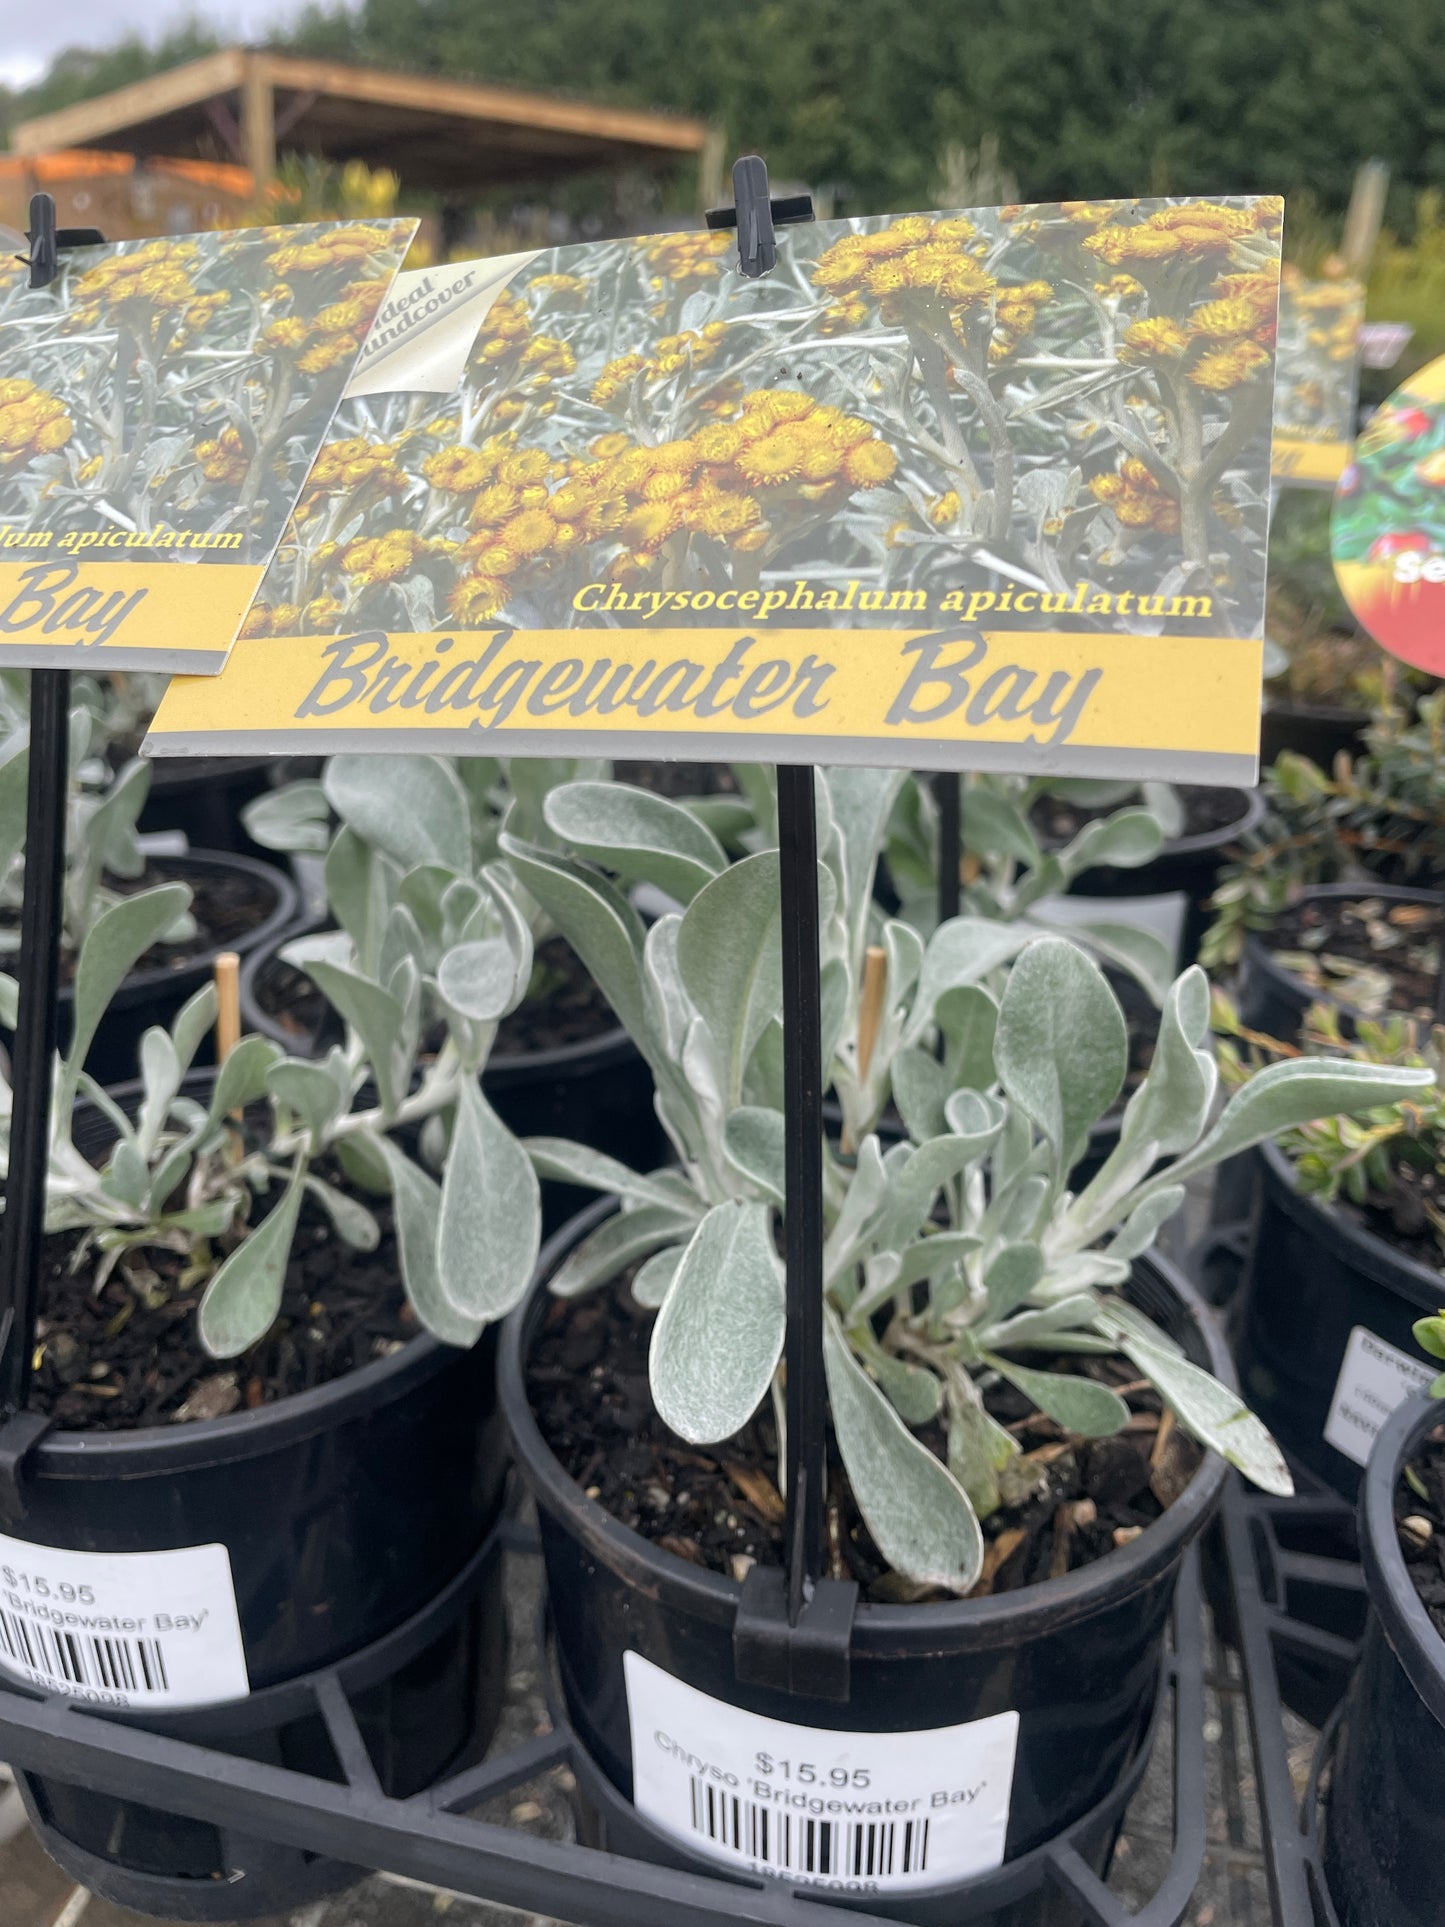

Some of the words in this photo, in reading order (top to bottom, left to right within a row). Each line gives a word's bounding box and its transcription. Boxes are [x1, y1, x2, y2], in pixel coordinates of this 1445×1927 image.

[358, 270, 476, 364] undcover
[56, 523, 244, 555] apiculatum
[0, 559, 149, 651] Bay
[572, 580, 927, 620] Chrysocephalum
[939, 582, 1213, 622] apiculatum
[294, 630, 837, 735] Bridgewater
[883, 627, 1104, 750] Bay
[1, 1565, 96, 1605] $15.95
[653, 1729, 740, 1788] Chryso
[755, 1751, 872, 1790] $15.95
